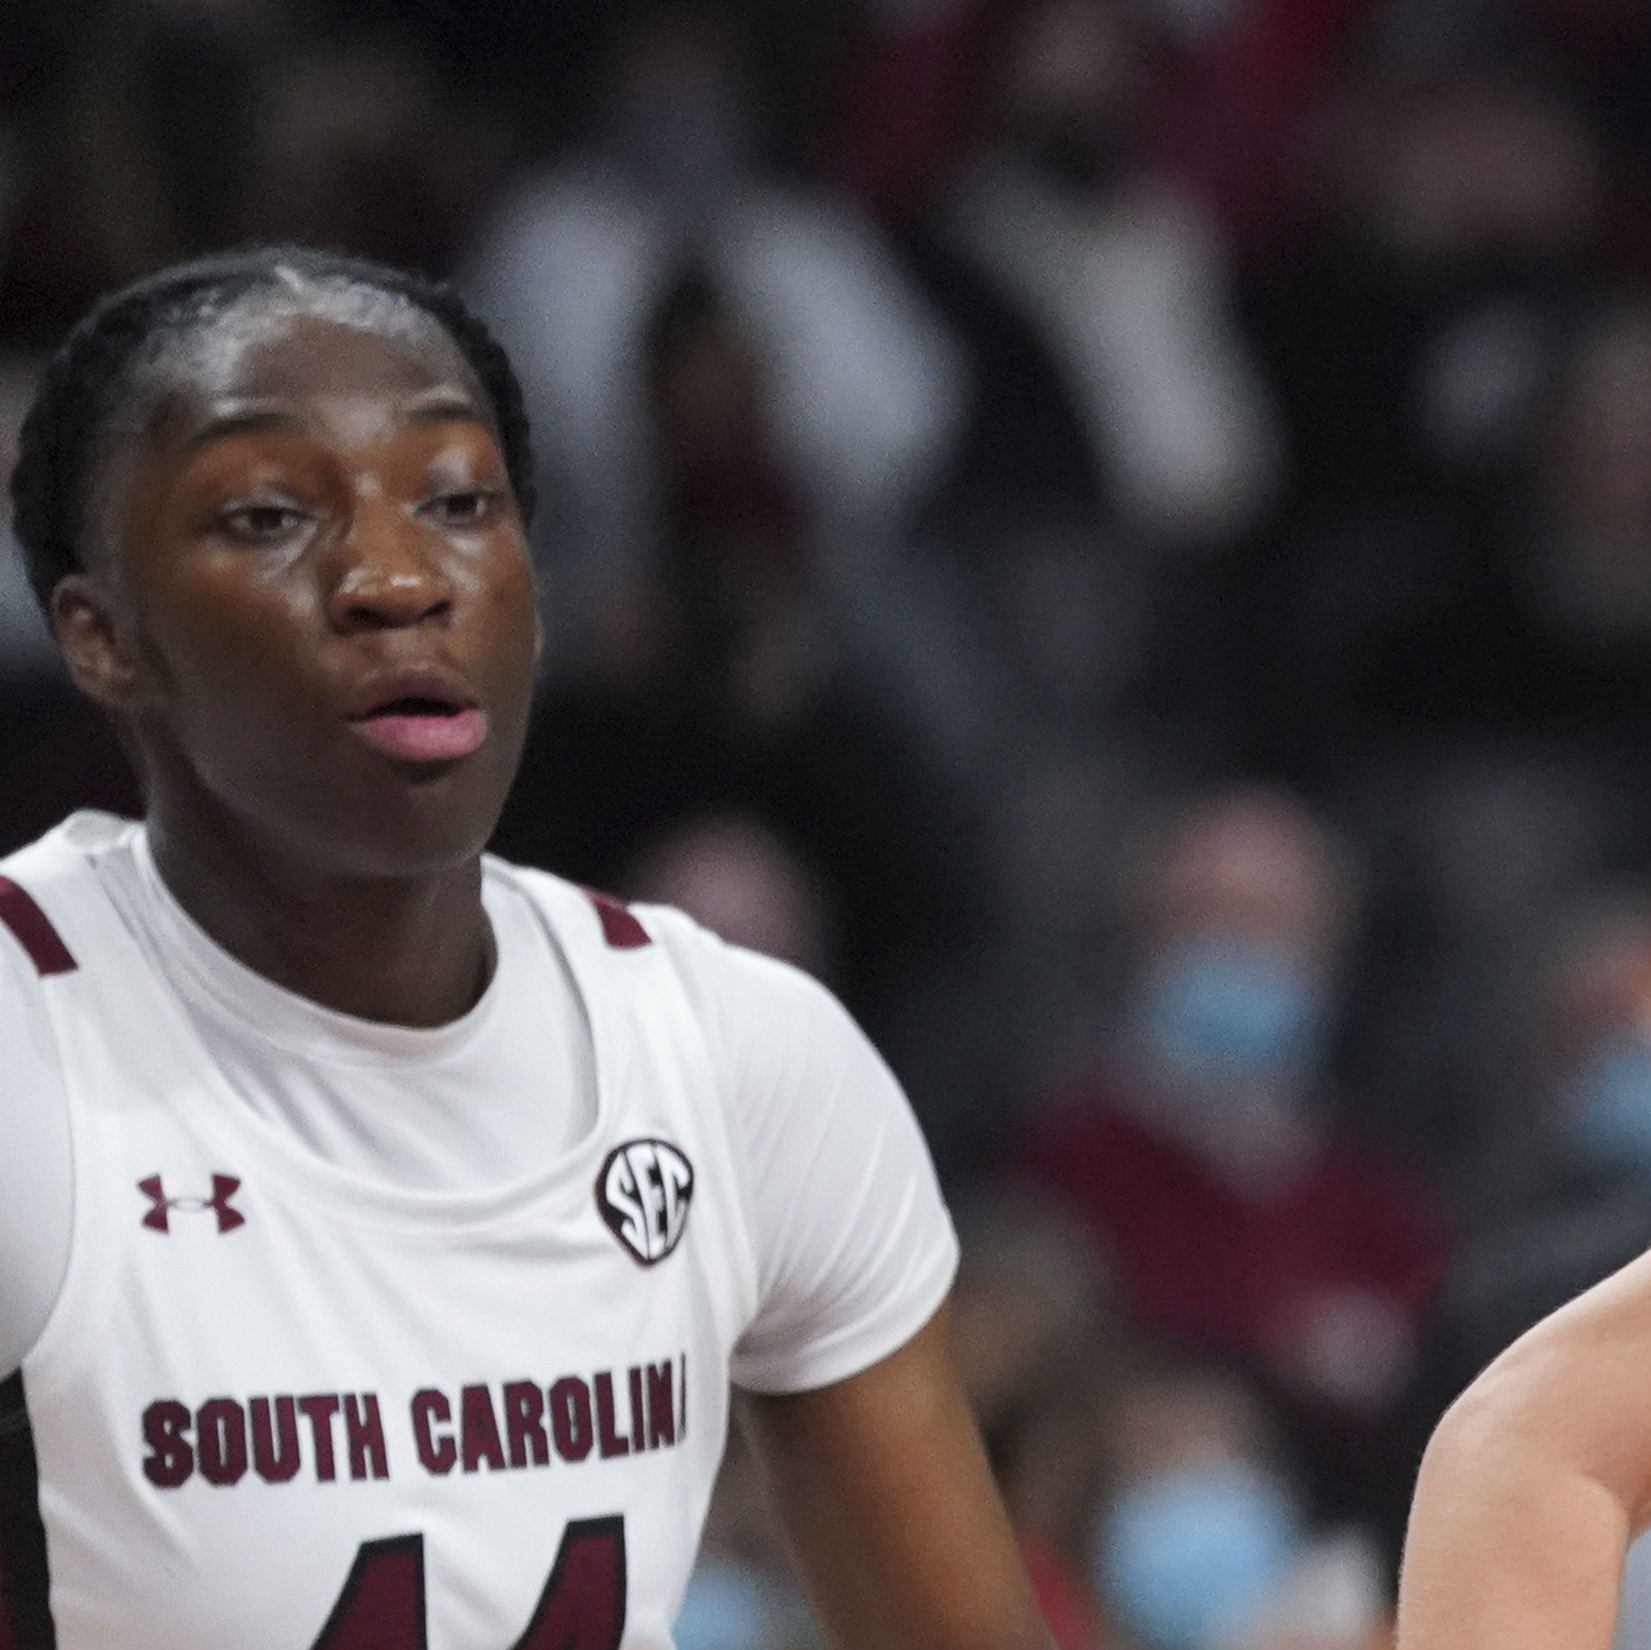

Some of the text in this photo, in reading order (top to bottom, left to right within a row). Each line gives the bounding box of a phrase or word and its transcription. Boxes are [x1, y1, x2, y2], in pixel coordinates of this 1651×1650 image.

[605, 1144, 690, 1259] SEC
[141, 1352, 687, 1488] SOUTH CAROLIN
